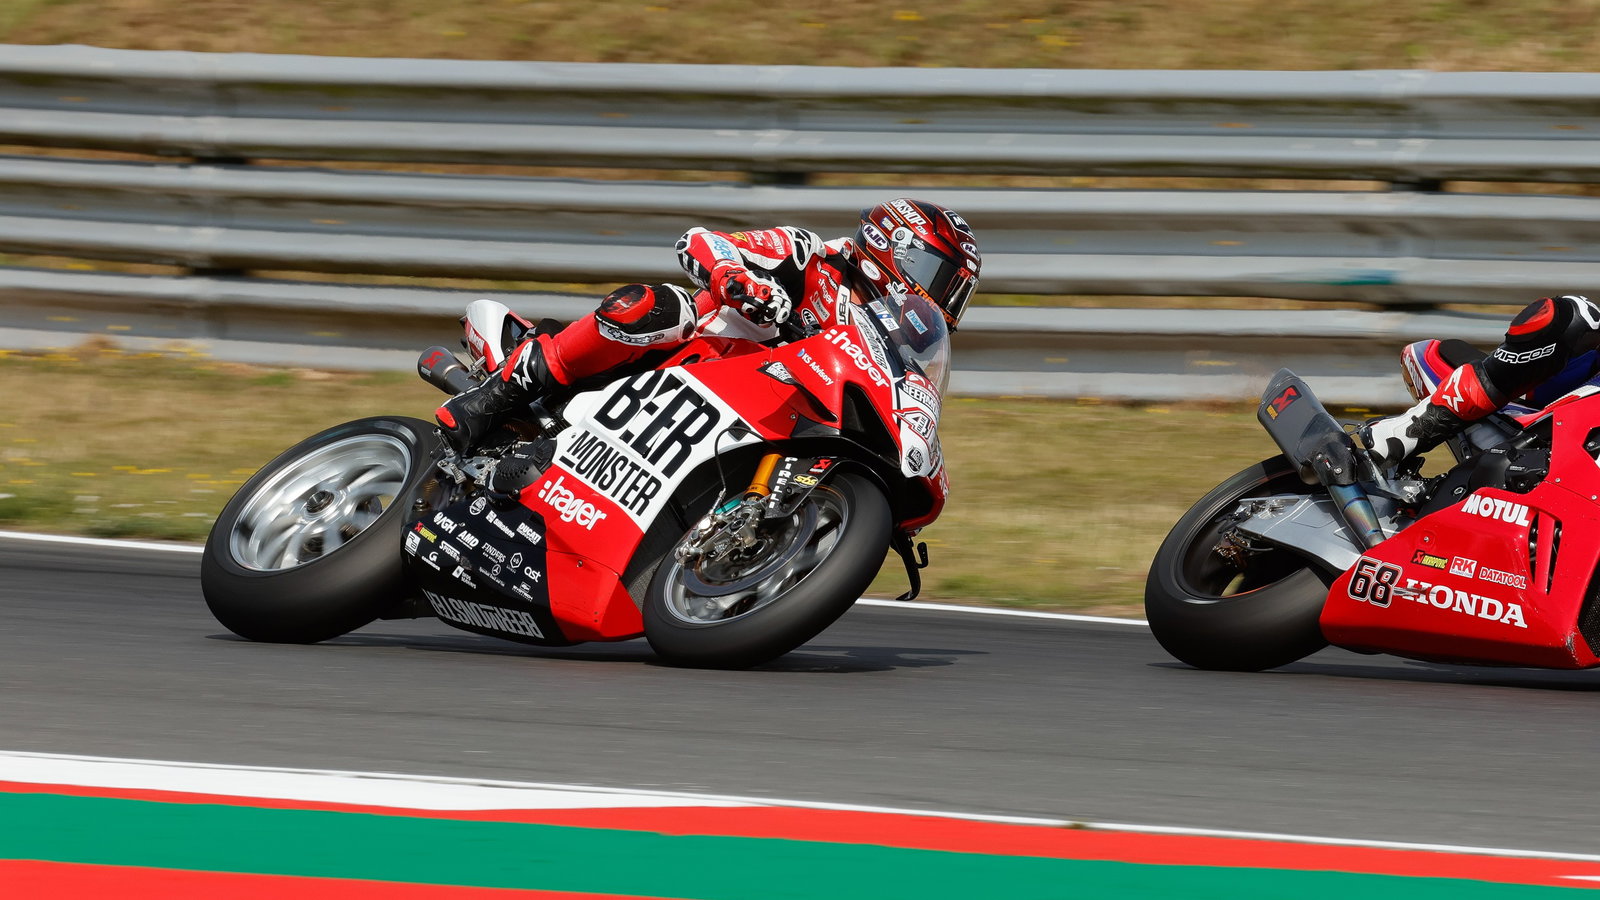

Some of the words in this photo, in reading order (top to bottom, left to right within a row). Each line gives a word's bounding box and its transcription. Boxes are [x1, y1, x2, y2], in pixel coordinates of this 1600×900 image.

[864, 225, 886, 247] HJC
[802, 353, 812, 365] KS
[809, 361, 834, 386] Advisory
[559, 430, 662, 517] MONSTER
[768, 457, 798, 509] PIRELLI
[1461, 494, 1531, 527] MOTUL
[457, 529, 480, 548] AMD
[517, 522, 541, 542] DUCATI
[1348, 556, 1403, 608] 68
[1452, 558, 1475, 574] RK
[1479, 567, 1526, 589] DATATOOL
[1401, 578, 1528, 628] HONDA
